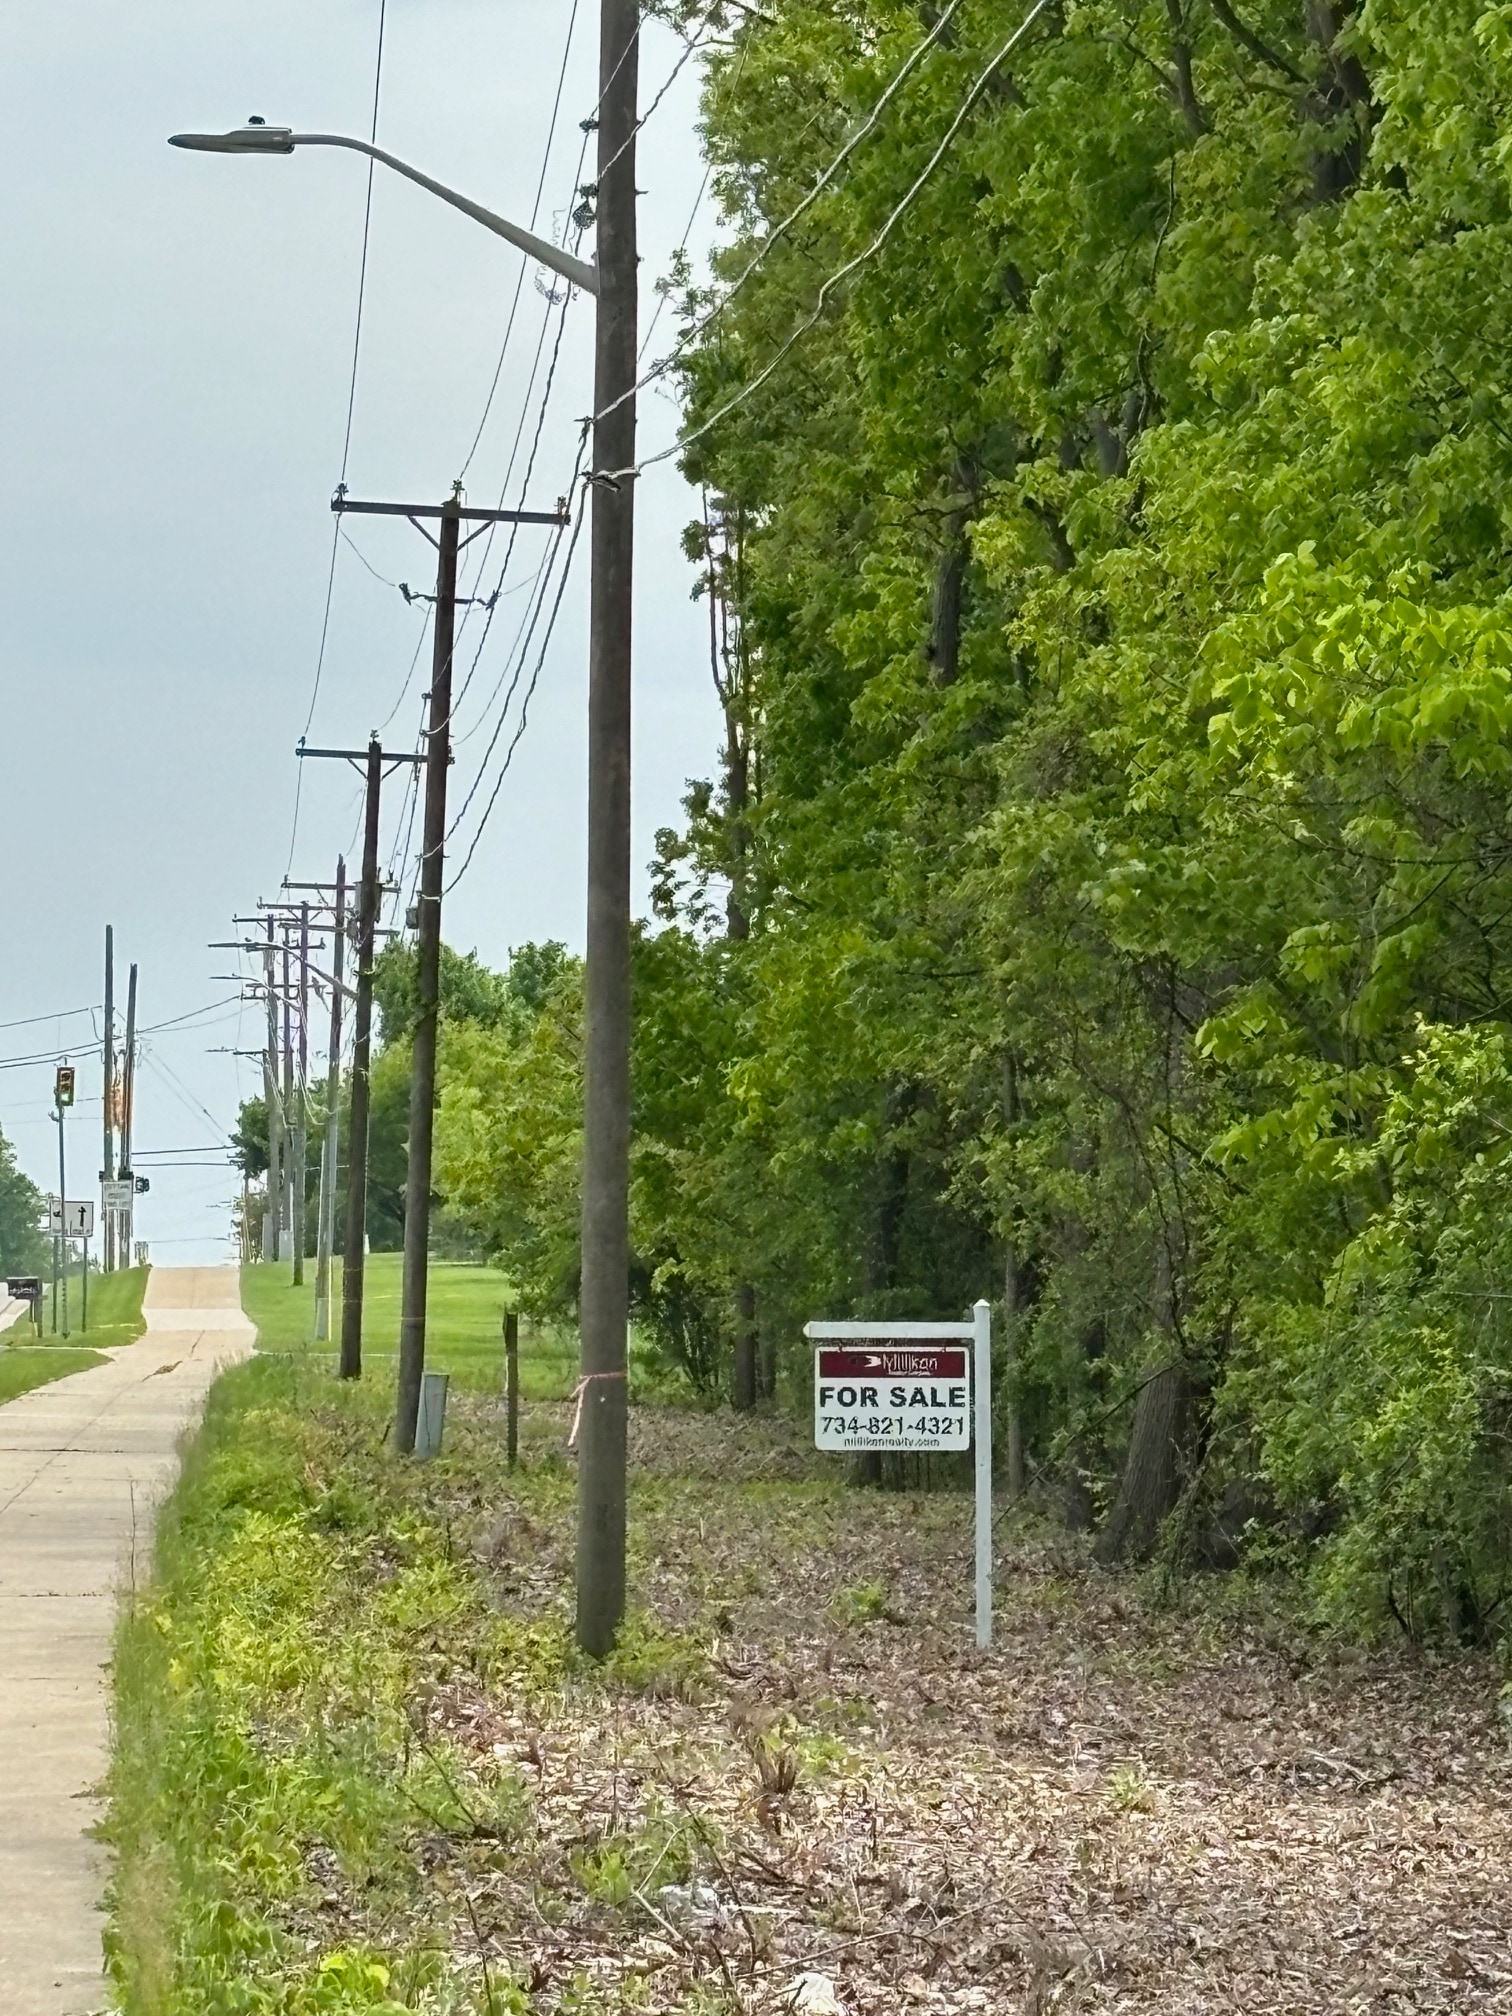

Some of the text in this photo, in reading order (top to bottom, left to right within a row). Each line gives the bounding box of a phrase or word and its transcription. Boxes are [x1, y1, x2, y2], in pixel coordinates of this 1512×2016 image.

[819, 1386, 966, 1408] FOR SALE
[821, 1416, 964, 1435] 734-821-4321
